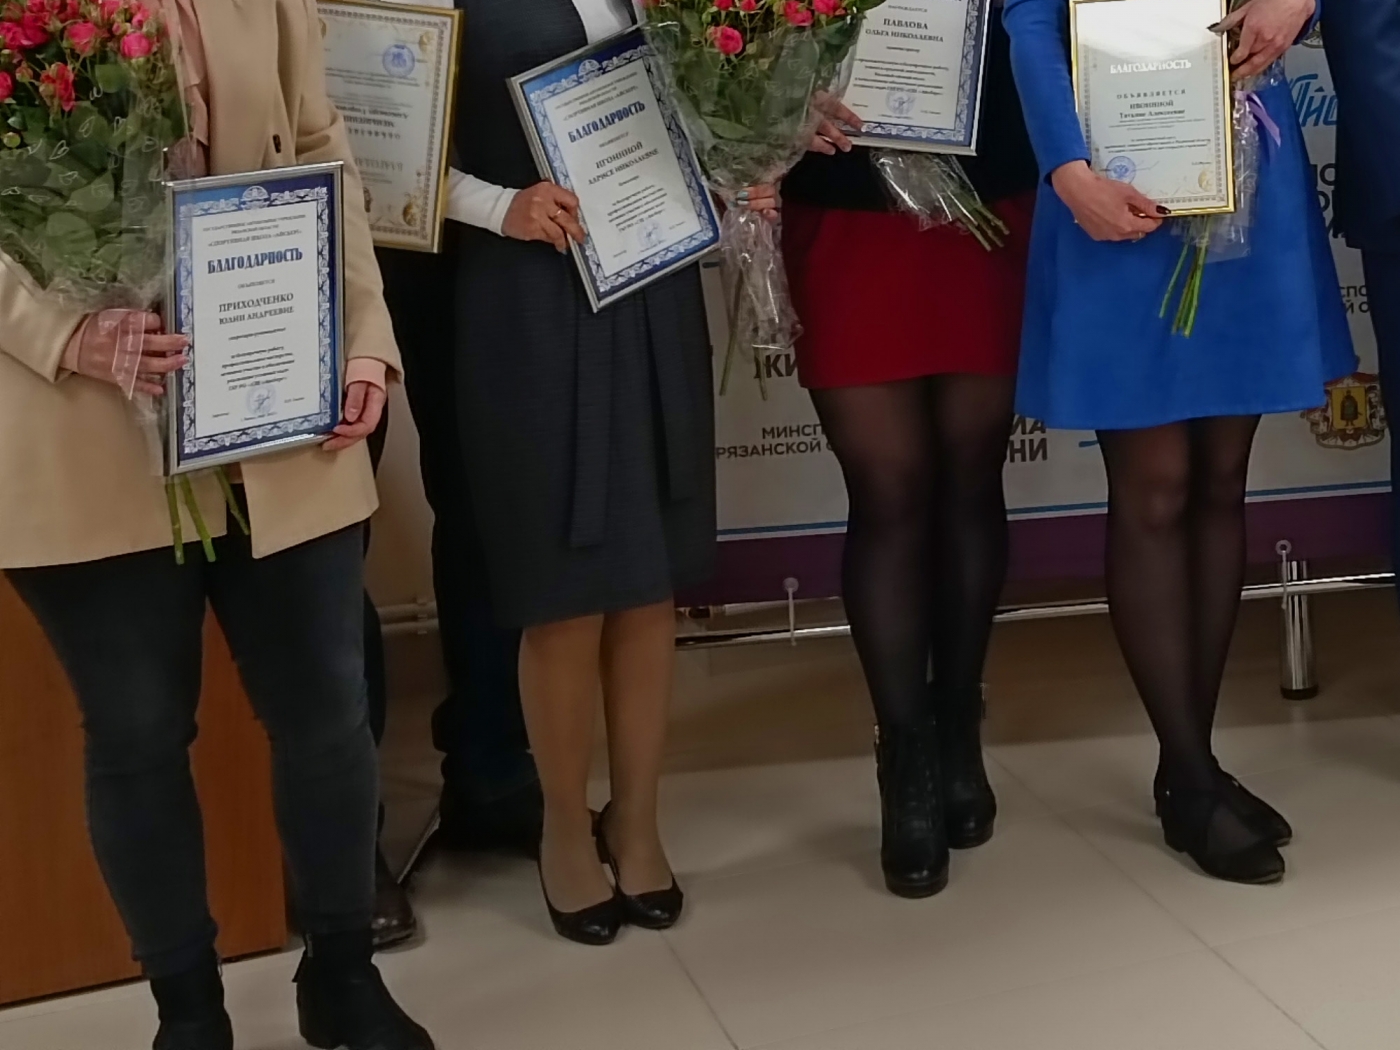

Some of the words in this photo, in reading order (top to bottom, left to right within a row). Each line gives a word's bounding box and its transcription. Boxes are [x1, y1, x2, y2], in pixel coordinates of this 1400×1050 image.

[567, 100, 646, 144] БЛАГОДАРНОСТЬ
[207, 247, 303, 275] БЛАГОДАРНОСТЬ
[218, 293, 294, 313] ПРИХОДЧЕНКО
[762, 423, 824, 440] МИНСП
